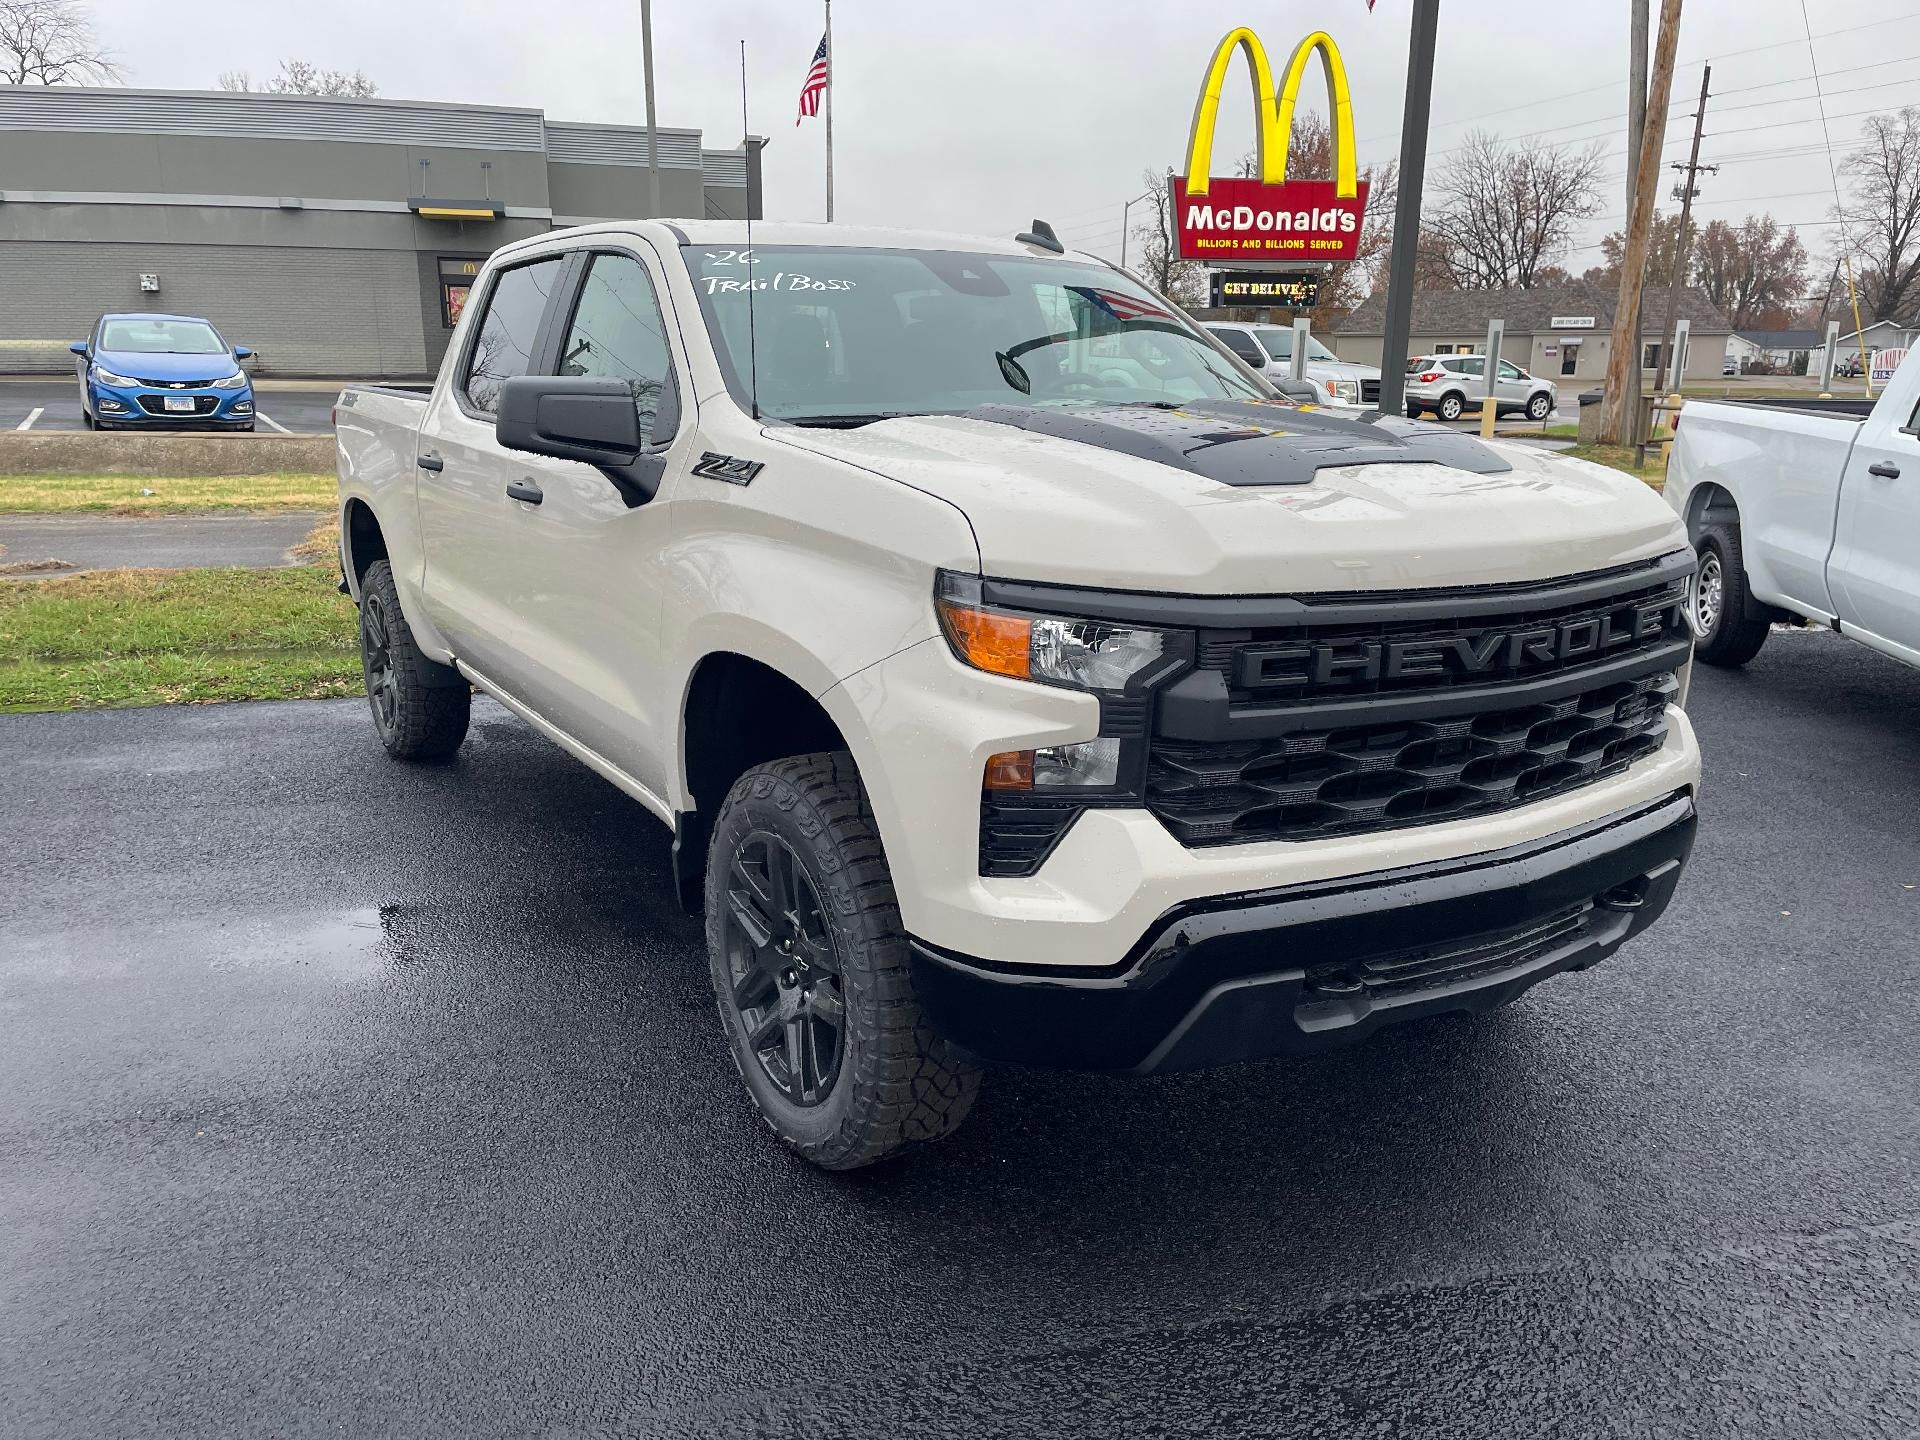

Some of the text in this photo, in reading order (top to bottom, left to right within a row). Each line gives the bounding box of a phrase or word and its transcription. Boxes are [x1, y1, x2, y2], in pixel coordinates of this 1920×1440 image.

[1185, 205, 1356, 232] McDonald's
[1197, 239, 1343, 250] BILLIONS AND BILLIONS SERVED
[1224, 282, 1249, 295] GET
